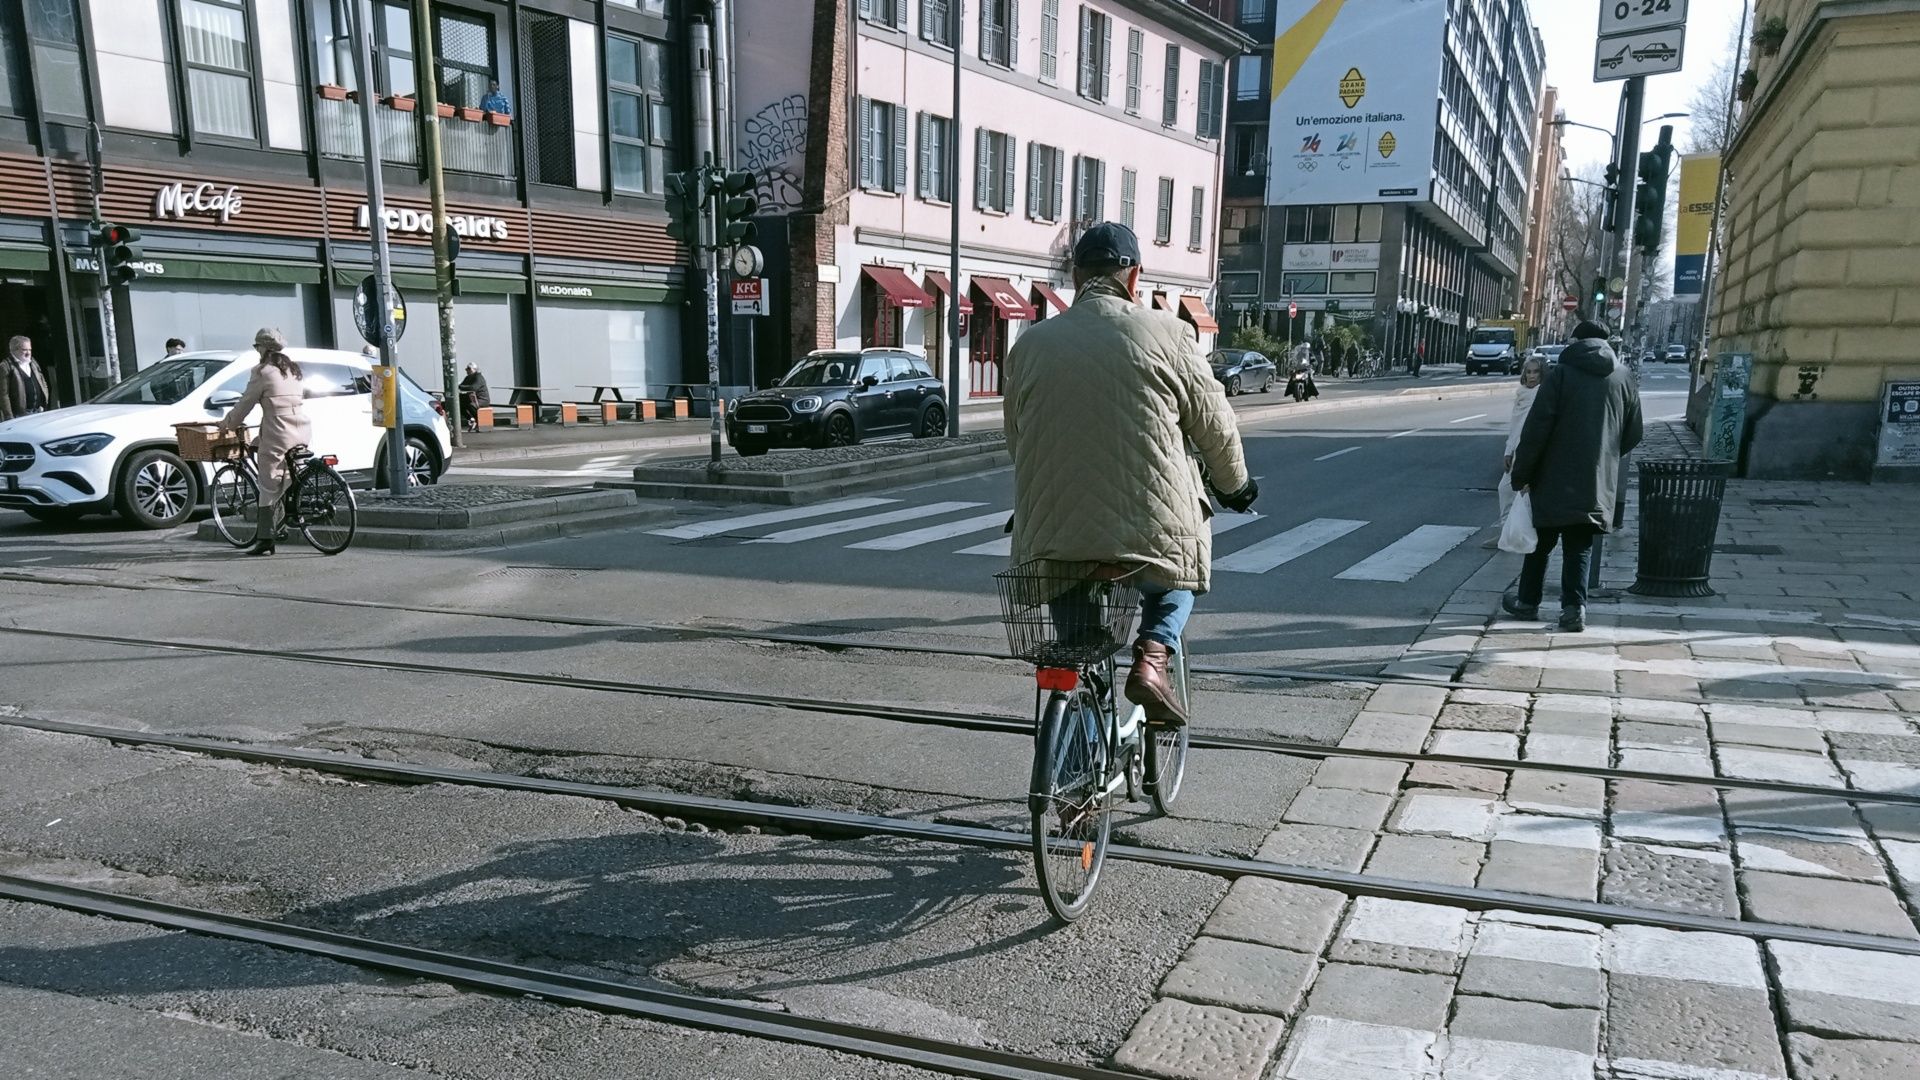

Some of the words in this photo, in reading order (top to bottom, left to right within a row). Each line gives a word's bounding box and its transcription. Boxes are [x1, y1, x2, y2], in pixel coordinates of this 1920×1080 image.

[1614, 0, 1672, 20] 0-24
[1296, 115, 1363, 126] Un'emozione
[1365, 112, 1405, 123] italiana.
[157, 182, 242, 224] McCafé
[540, 284, 593, 297] McDonald's
[735, 282, 758, 295] KFC
